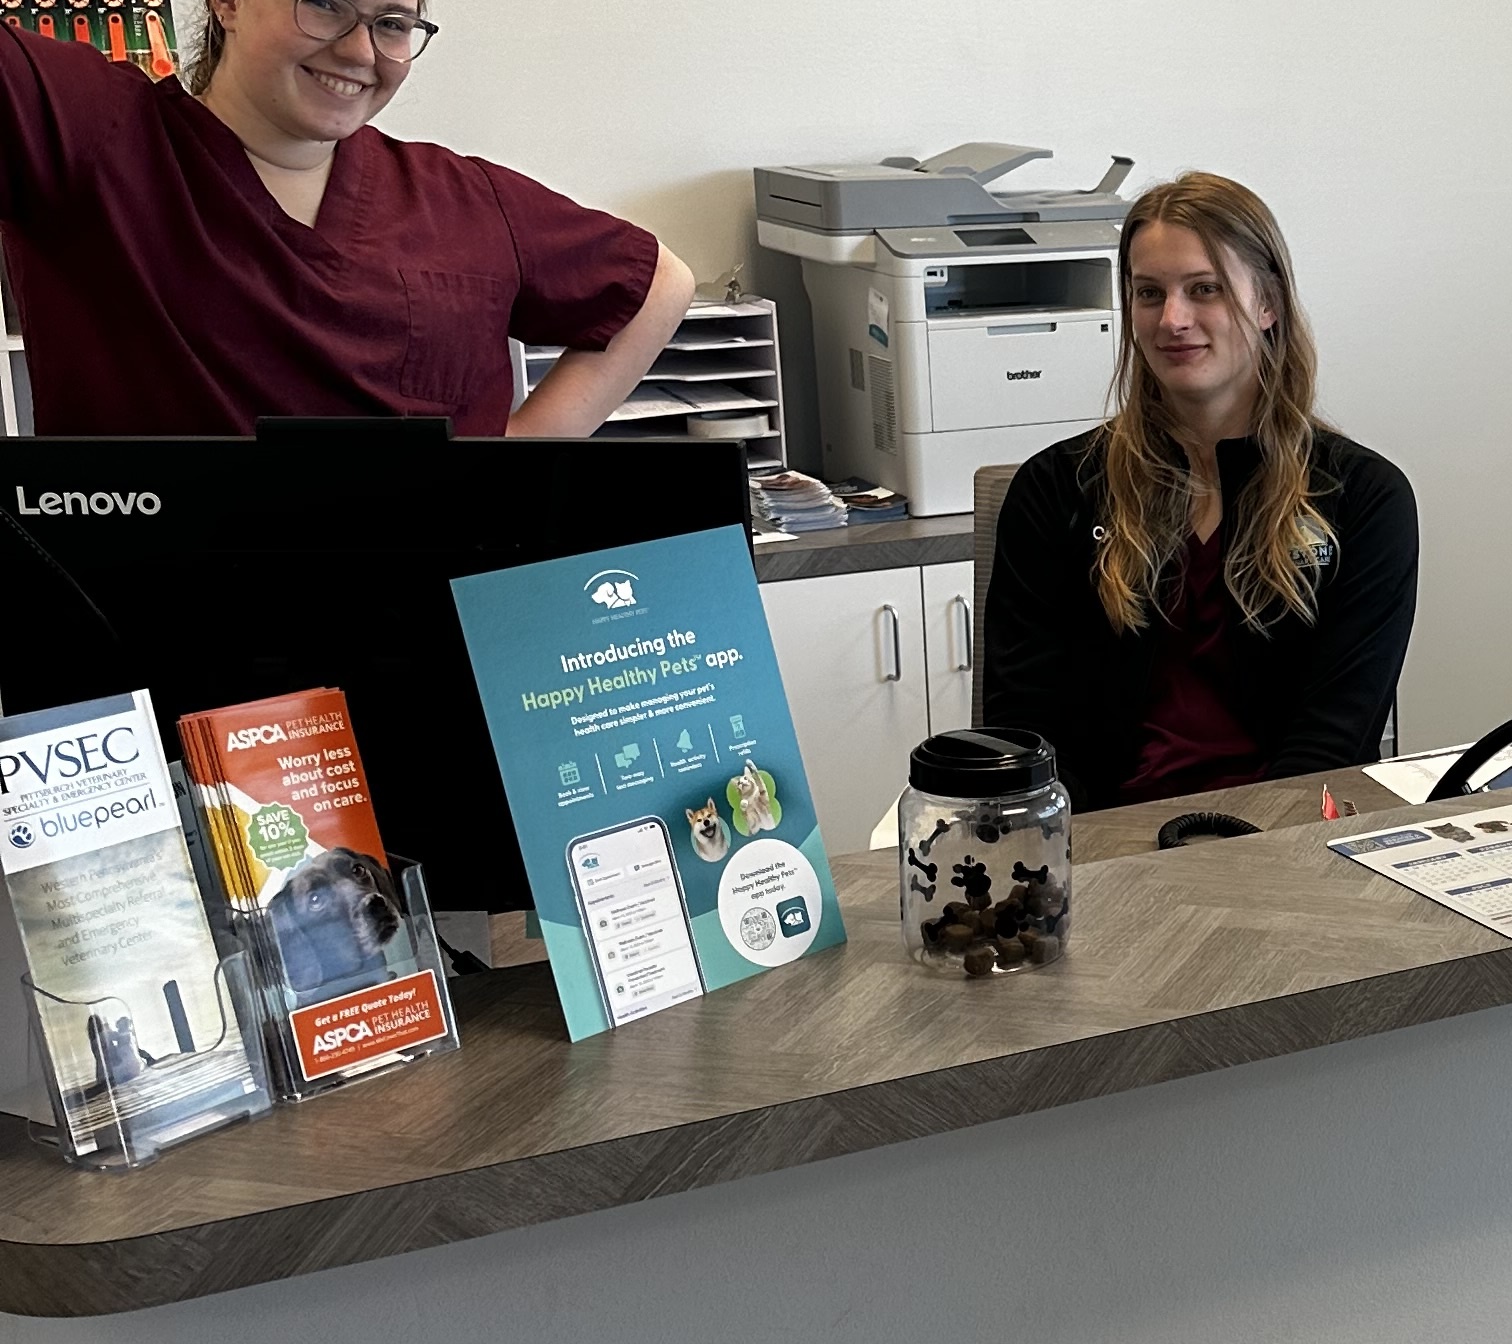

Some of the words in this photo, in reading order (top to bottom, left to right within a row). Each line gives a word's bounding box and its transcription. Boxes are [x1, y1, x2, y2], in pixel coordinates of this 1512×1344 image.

[1006, 369, 1043, 381] brother
[16, 486, 161, 515] Lenovo
[560, 637, 666, 673] Introducing
[667, 629, 696, 649] the
[521, 684, 584, 712] Happy
[587, 665, 657, 696] Healthy
[705, 647, 744, 669] app.
[570, 708, 608, 726] Designed
[609, 706, 618, 716] to
[618, 701, 641, 714] make
[641, 692, 679, 709] managing
[679, 688, 696, 701] your
[574, 721, 600, 737] health
[601, 718, 619, 729] care
[619, 711, 648, 726] simpler
[648, 709, 655, 718] &
[655, 705, 675, 716] more
[227, 723, 288, 752] ASPCA
[286, 718, 303, 730] PET
[304, 711, 343, 726] HEALTH
[288, 720, 345, 740] INSURANCE
[0, 727, 139, 795] PVSEC
[277, 752, 321, 770] Worry
[323, 746, 352, 761] less
[282, 768, 324, 787] about
[326, 760, 356, 777] cost
[3, 798, 50, 817] SPECIALTY
[53, 795, 59, 804] &
[61, 782, 112, 801] EMERGENCY
[115, 772, 147, 787] CENTER
[20, 783, 74, 802] PITTSBURGH
[76, 768, 128, 788] VETERINARY
[291, 784, 319, 801] and
[321, 777, 360, 794] focus
[40, 788, 156, 837] bluepearl
[256, 809, 290, 826] SAVE
[313, 799, 332, 812] on
[334, 792, 368, 808] care.
[259, 821, 296, 842] 10%
[40, 873, 88, 894] Western
[46, 895, 77, 912] Most
[78, 871, 157, 903] Comprehensive
[51, 899, 126, 930] Multispecialty
[127, 886, 166, 906] Referral
[57, 931, 80, 949] and
[81, 916, 139, 941] Emergency
[62, 943, 118, 966] Veterinary
[119, 930, 153, 948] Center
[314, 1016, 331, 1027] Get
[339, 1005, 360, 1020] FREE
[361, 998, 387, 1013] Quote
[389, 987, 417, 1003] Today!
[374, 1009, 431, 1035] INSURANCE
[313, 1020, 374, 1056] ASPCA
[372, 1013, 389, 1026] PET
[391, 1000, 429, 1017] HEALTH
